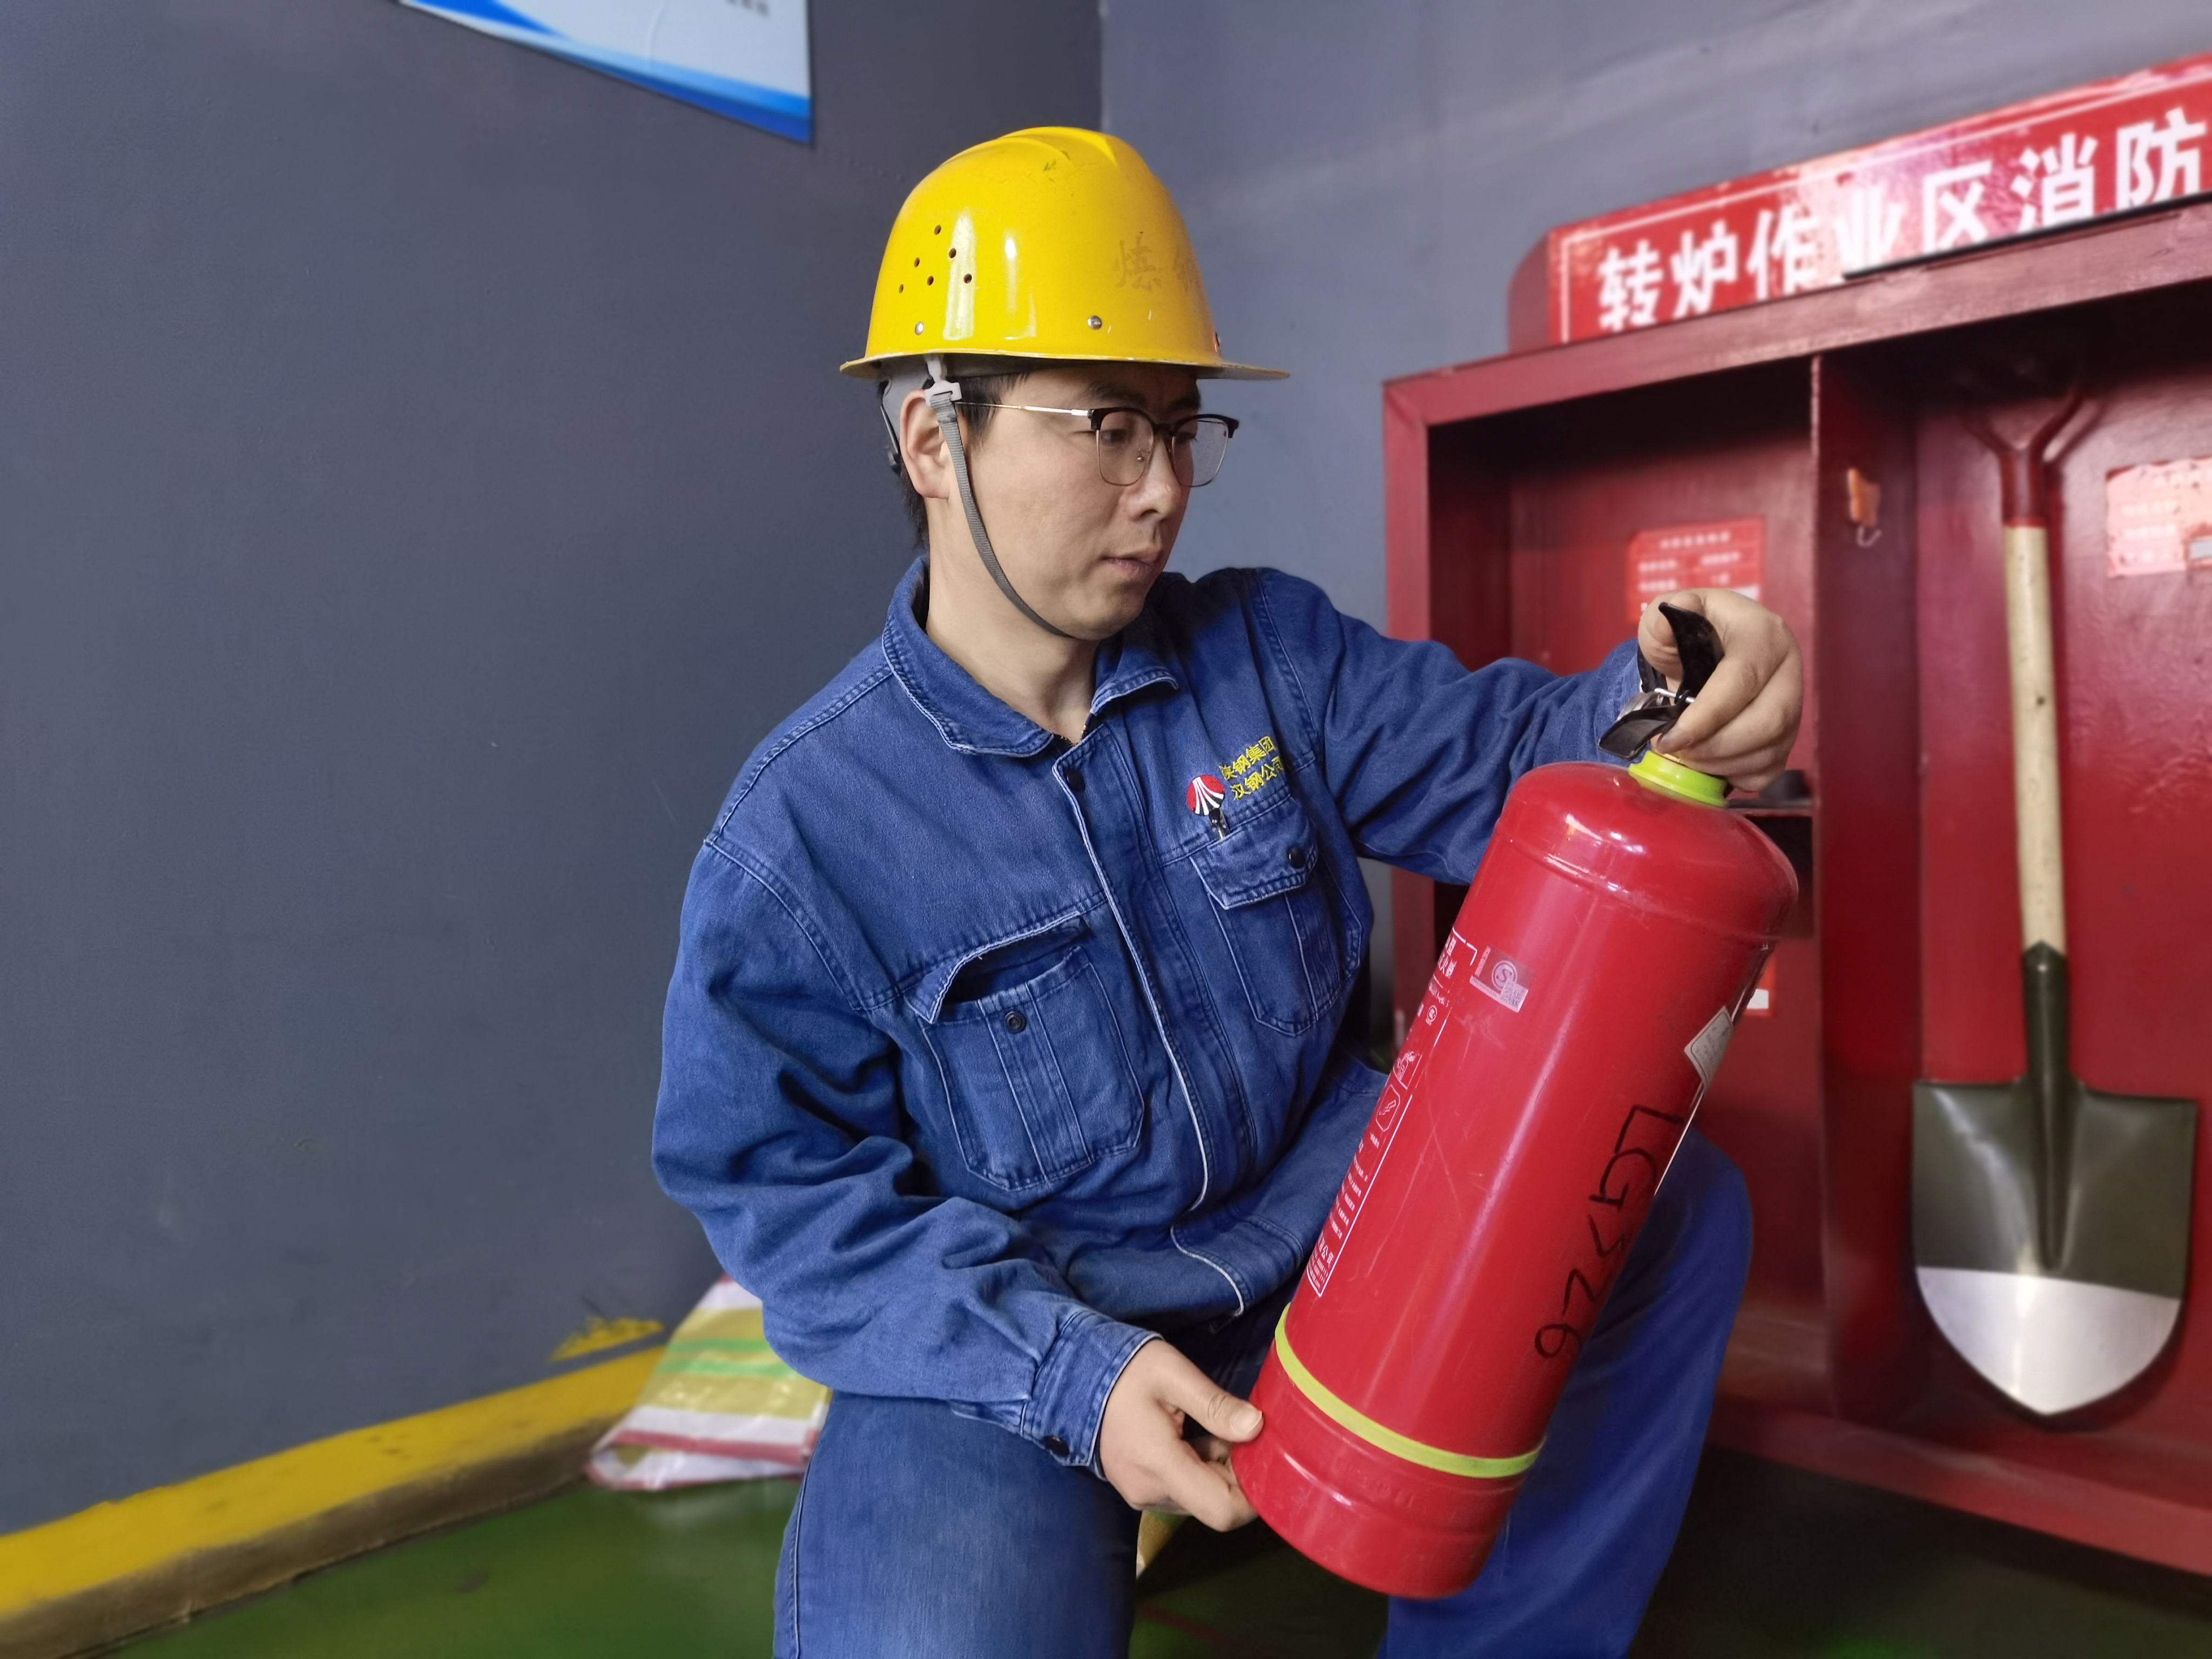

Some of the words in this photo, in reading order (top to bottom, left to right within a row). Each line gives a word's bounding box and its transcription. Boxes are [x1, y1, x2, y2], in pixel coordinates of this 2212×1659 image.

[1597, 107, 2207, 332] 转炉作业区消防
[1230, 756, 1284, 800] 汉钢公司
